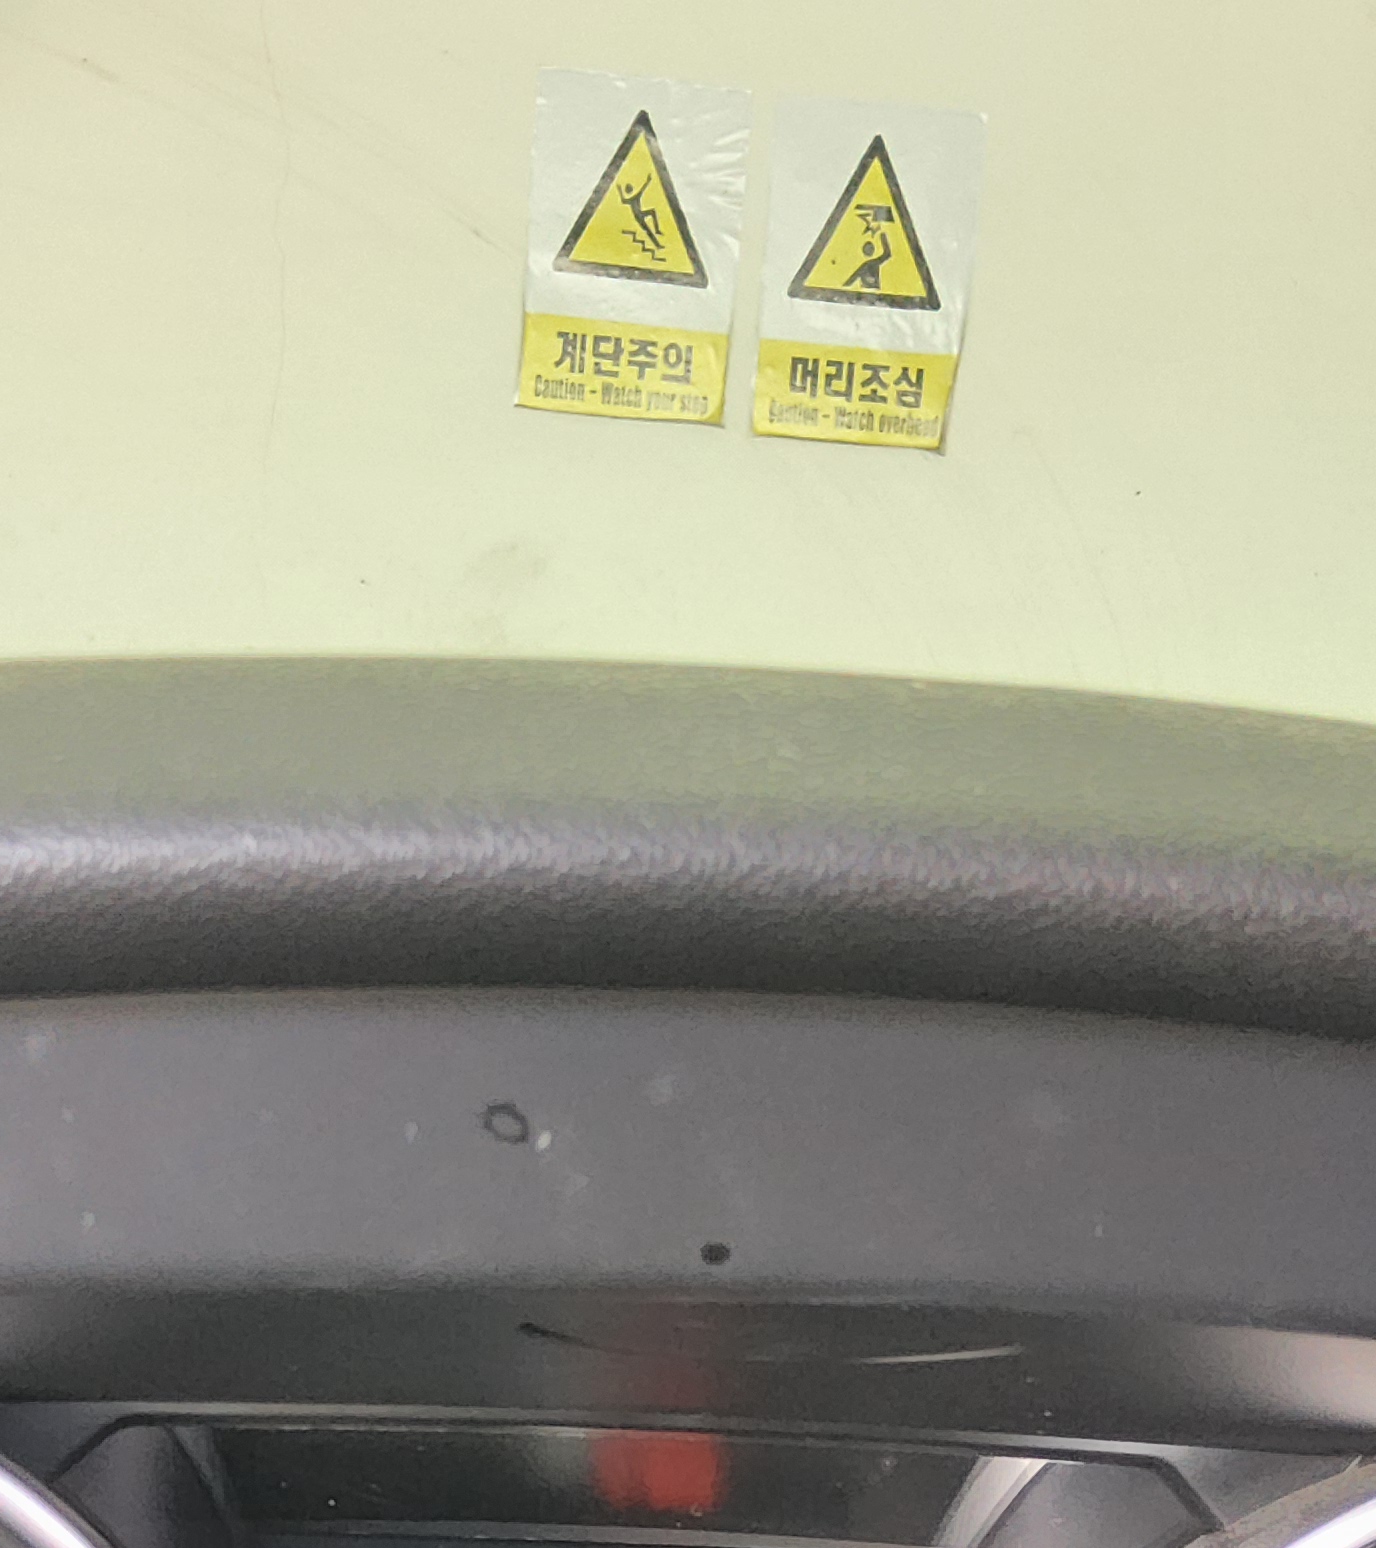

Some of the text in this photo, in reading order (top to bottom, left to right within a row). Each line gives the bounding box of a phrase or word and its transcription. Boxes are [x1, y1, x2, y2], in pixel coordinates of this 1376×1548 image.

[554, 331, 693, 385] 계단주의
[535, 375, 585, 401] Caution
[601, 382, 642, 408] Watch
[790, 356, 925, 408] 머리조심
[835, 407, 874, 431] Watch
